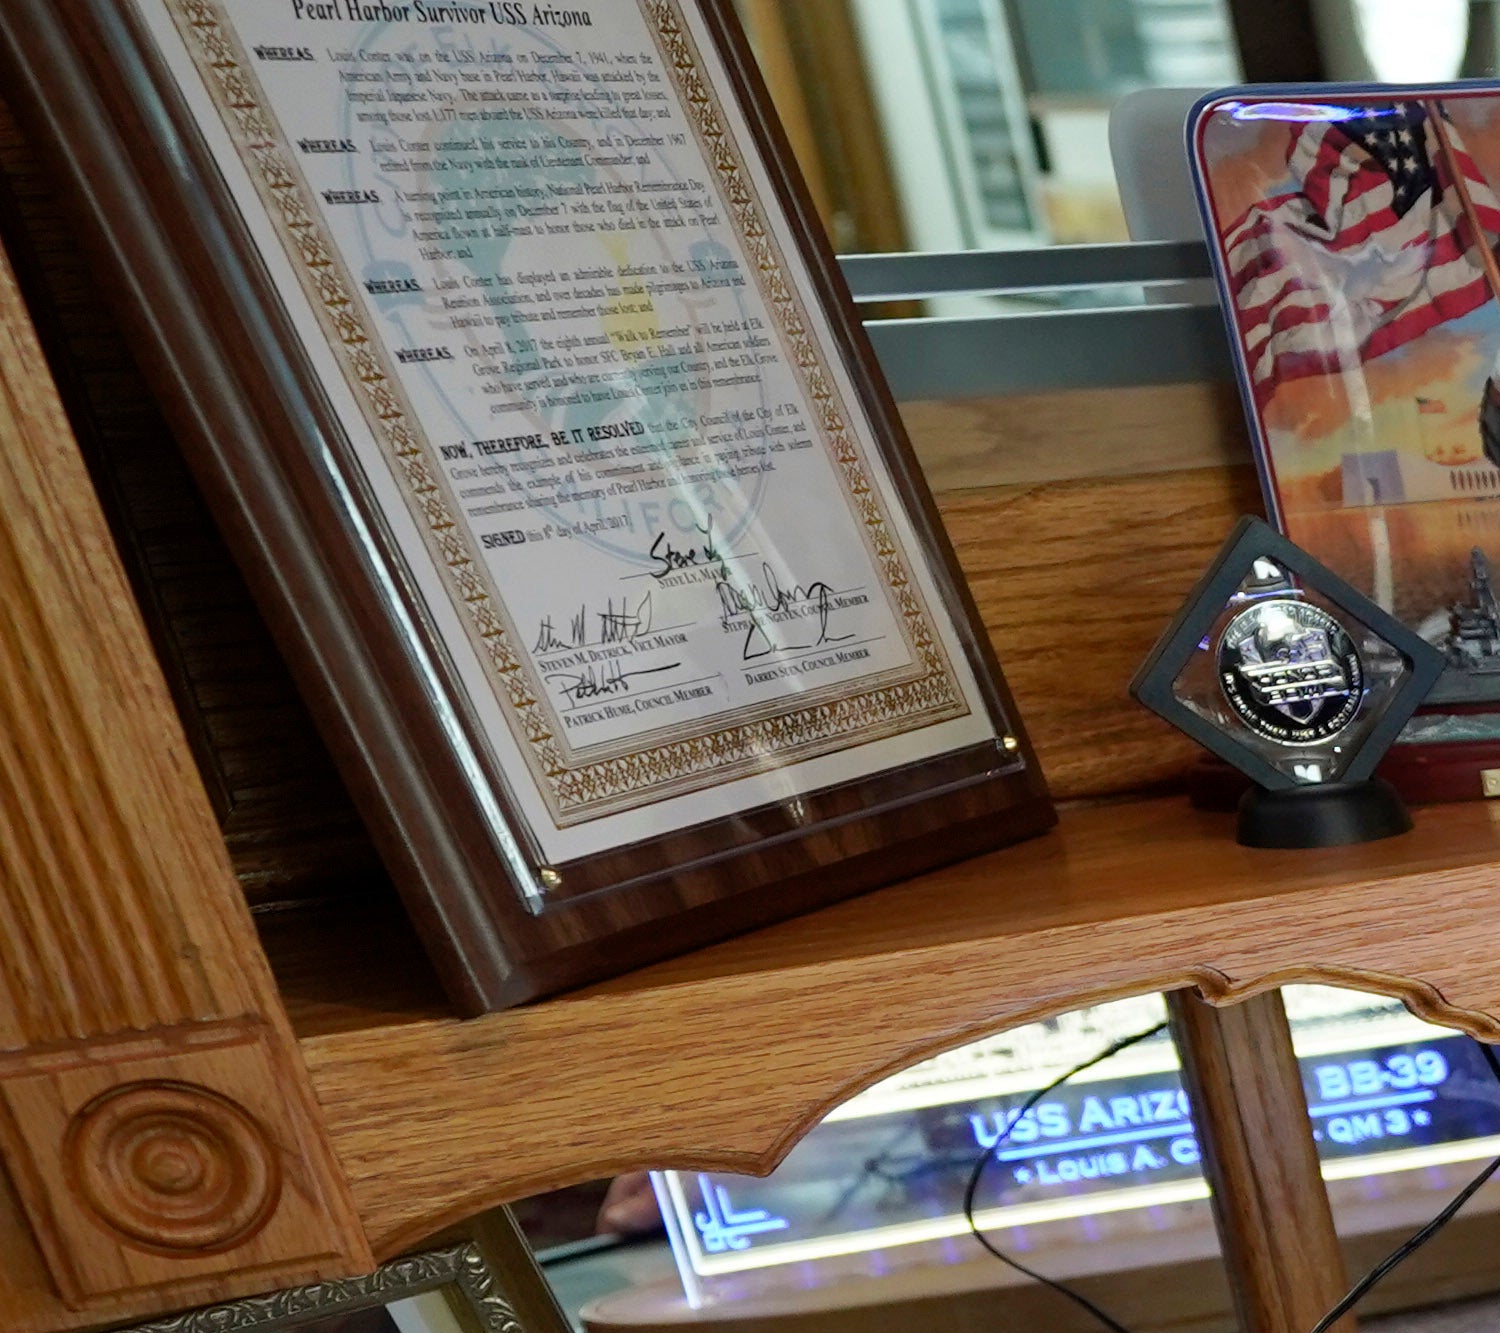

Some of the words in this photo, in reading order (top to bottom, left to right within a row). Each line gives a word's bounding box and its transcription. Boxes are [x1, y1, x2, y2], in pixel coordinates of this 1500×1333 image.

[291, 0, 342, 21] Pearl
[345, 0, 410, 23] Harbor
[412, 0, 486, 24] Survivor
[488, 1, 528, 26] USS
[532, 3, 593, 28] Arizona
[550, 430, 571, 446] BE
[570, 428, 585, 444] IT
[586, 420, 645, 442] RESOLVED
[480, 529, 527, 550] SIGNED
[627, 638, 656, 652] VICE
[652, 633, 689, 648] MAYOR
[672, 685, 714, 701] MEMBER
[969, 1102, 1076, 1150] USS
[1078, 1090, 1192, 1133] ARIZ
[1317, 1048, 1450, 1099] BB-39
[1036, 1154, 1128, 1185] LOUIS
[1328, 1118, 1382, 1145] QM
[1383, 1111, 1410, 1138] 3
